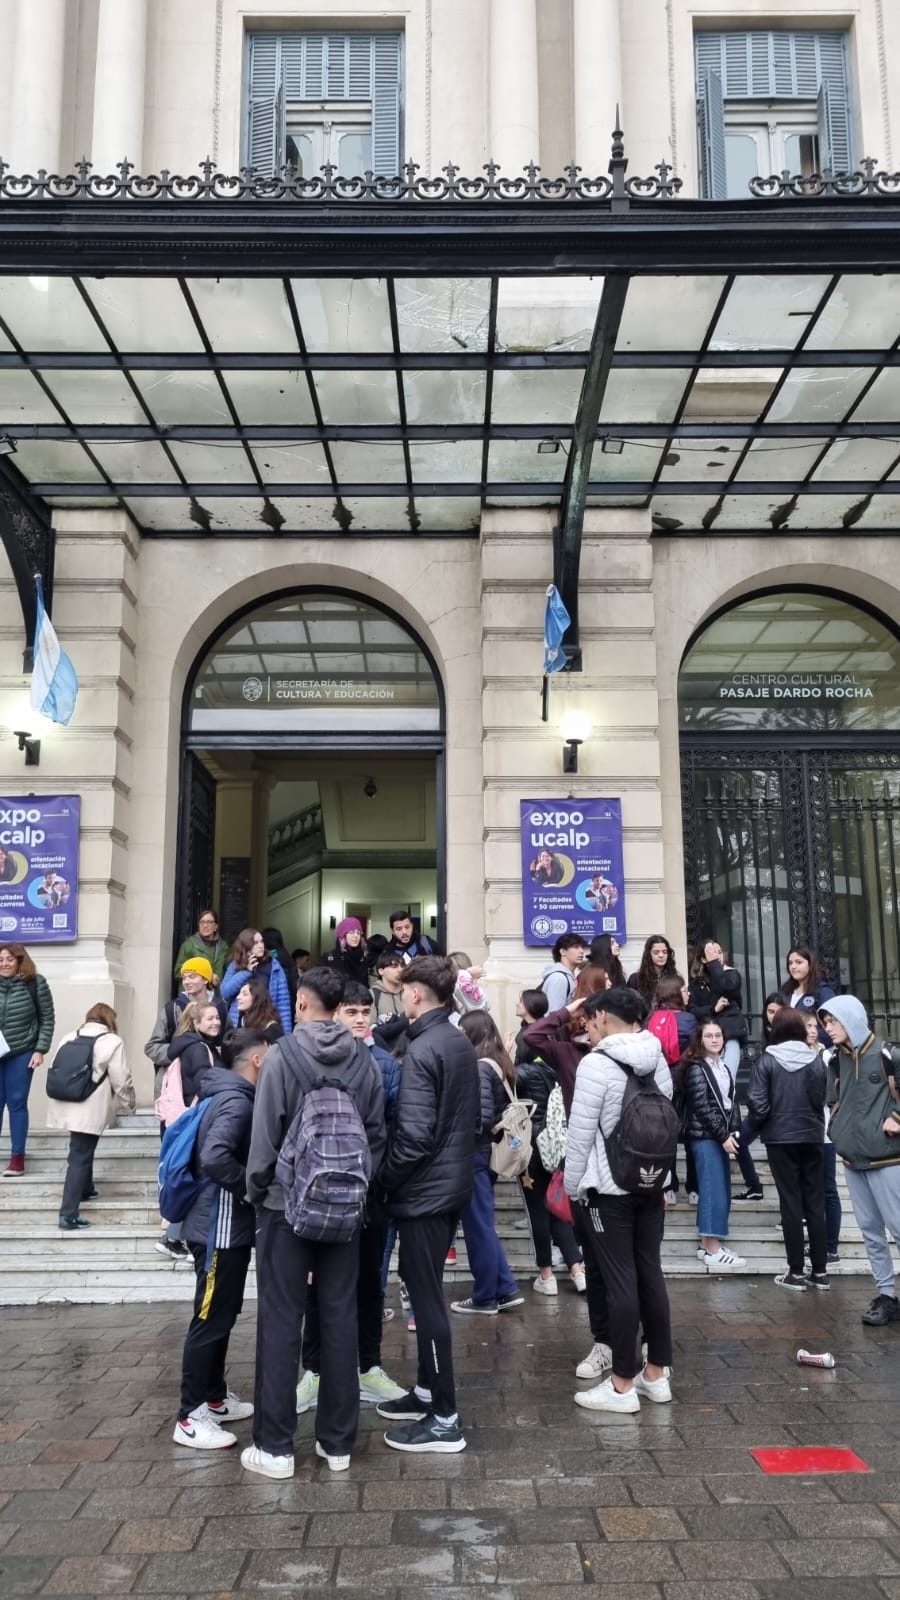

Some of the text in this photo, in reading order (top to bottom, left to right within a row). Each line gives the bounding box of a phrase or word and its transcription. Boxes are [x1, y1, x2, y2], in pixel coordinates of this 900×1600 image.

[276, 678, 353, 688] SECRETARÍA DE
[732, 674, 859, 685] CENTRO CULTURAL
[276, 690, 322, 699] CULTURA
[334, 689, 394, 699] EDUCACIÓN
[720, 688, 873, 698] PASAJE DARDO ROCHA
[0, 809, 41, 826] xpo
[530, 811, 584, 829] expo
[0, 826, 46, 847] calp
[531, 828, 590, 850] ucalp
